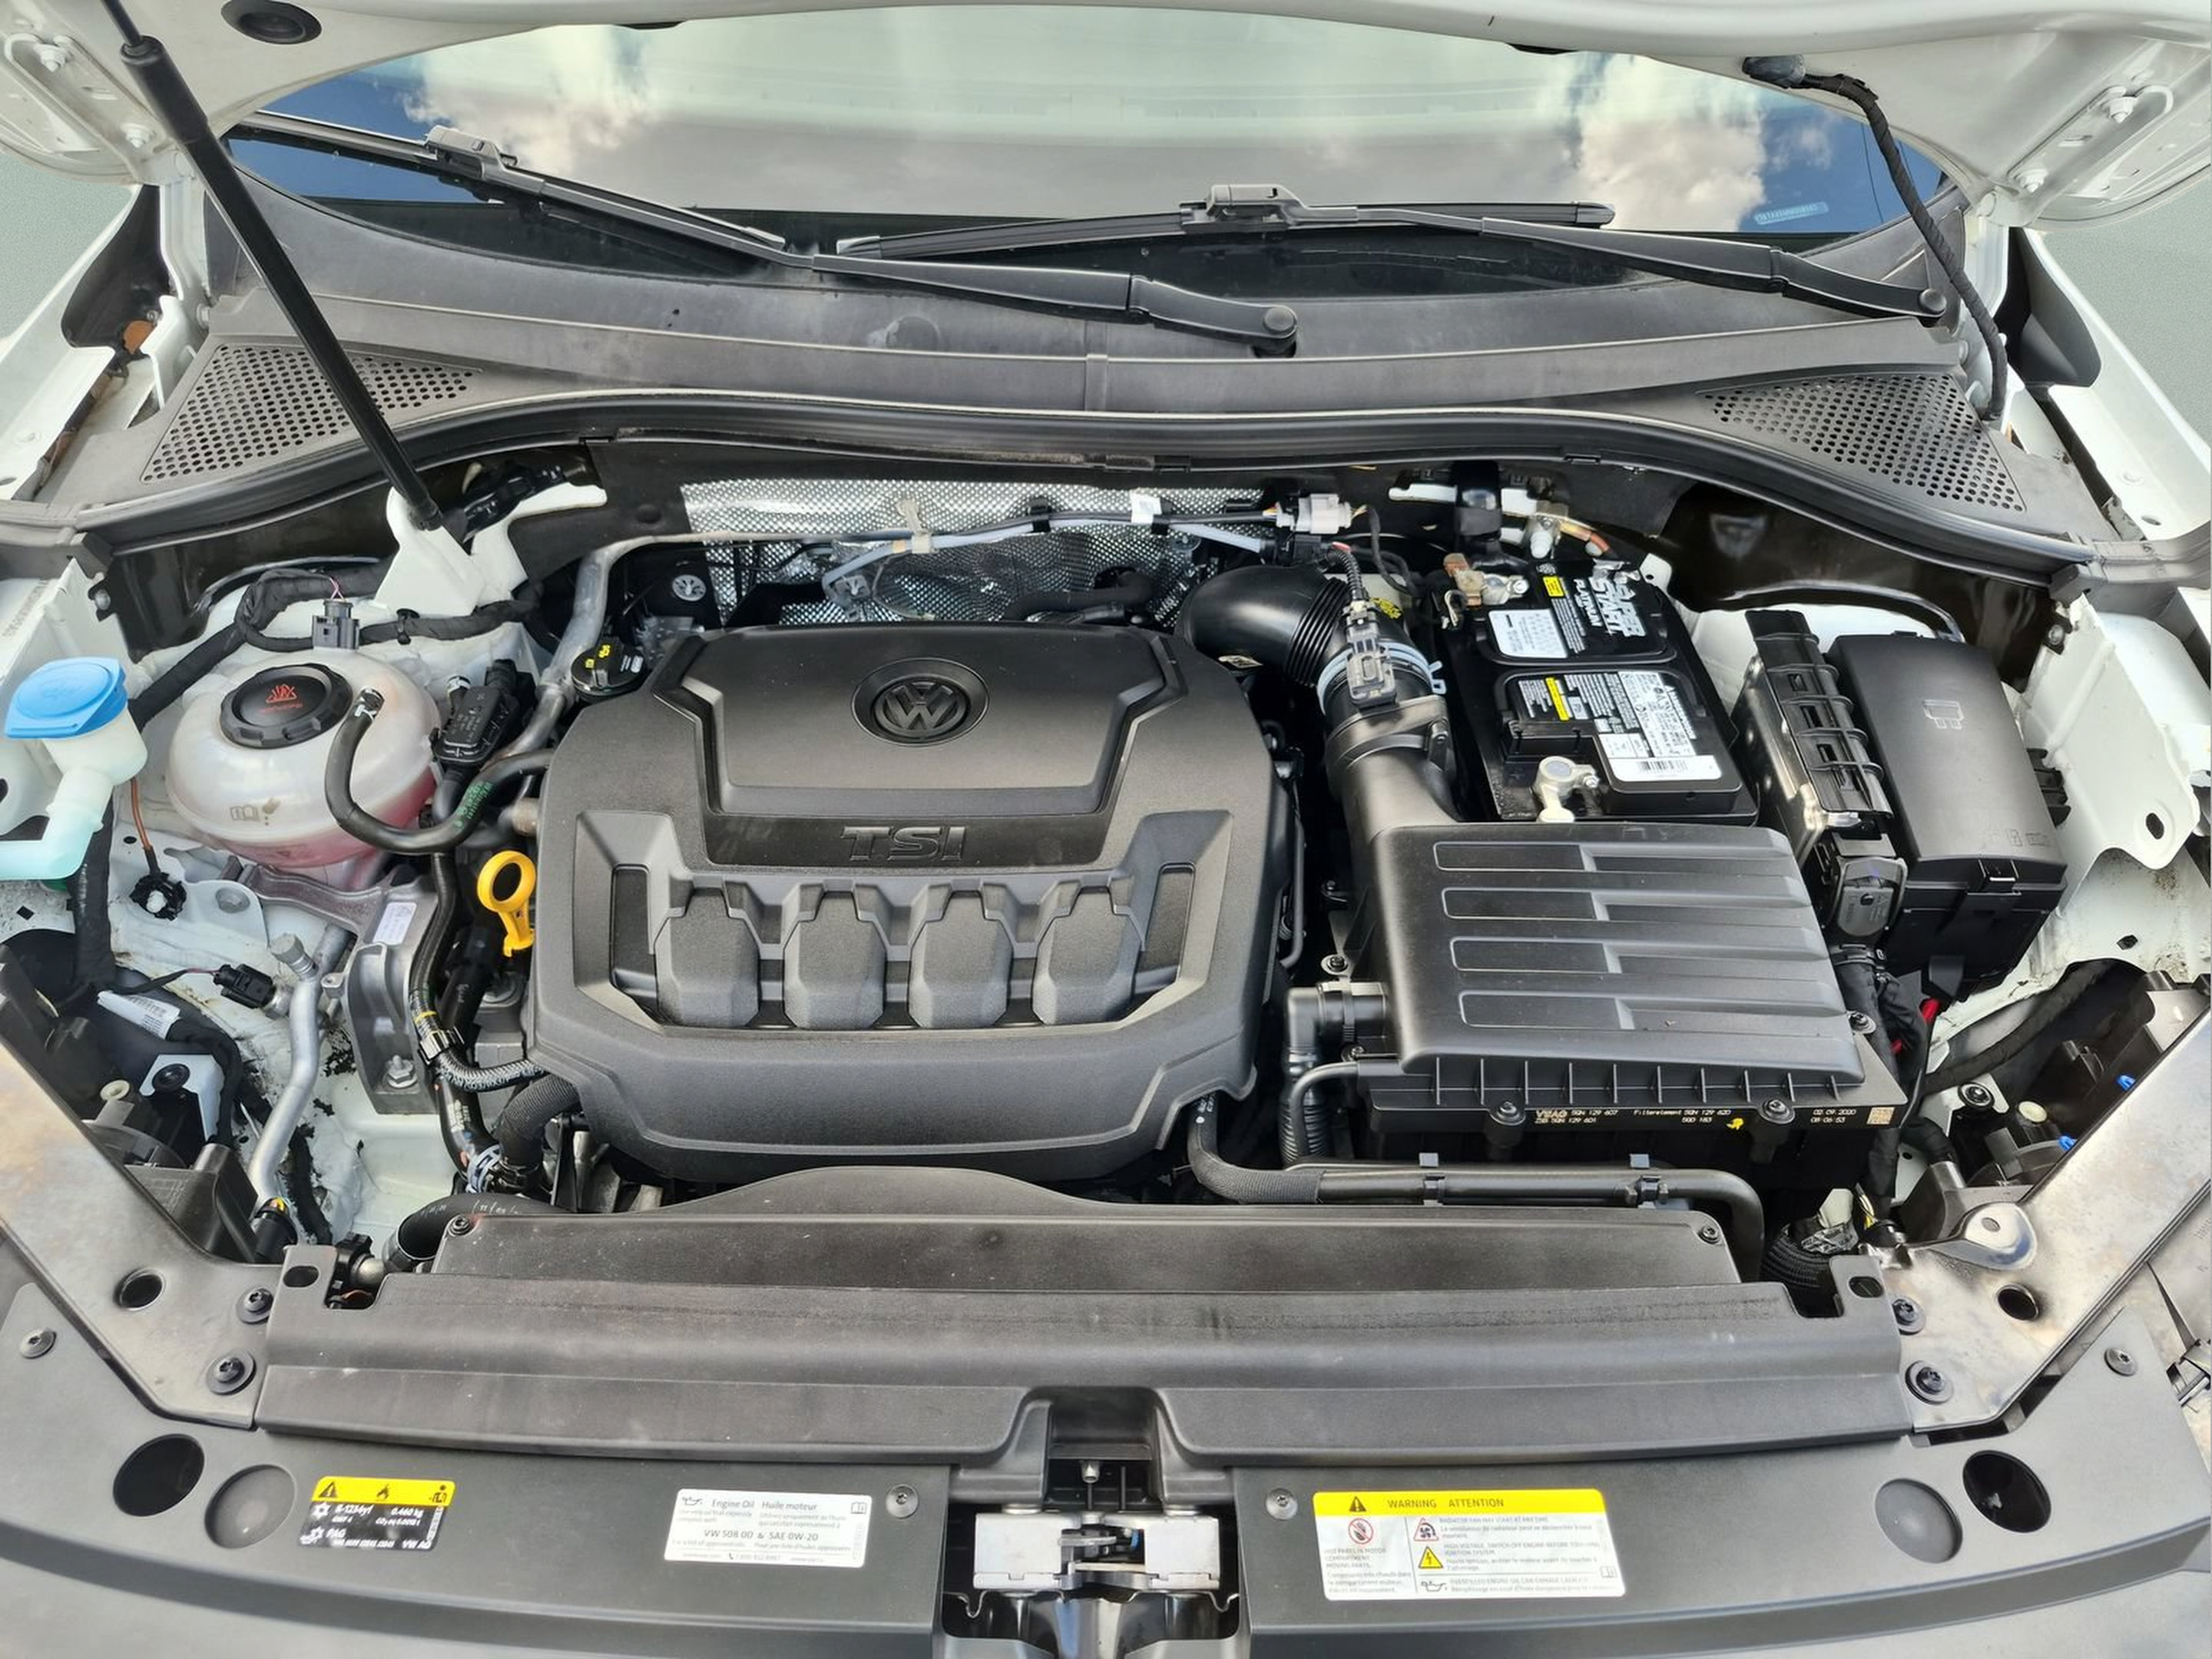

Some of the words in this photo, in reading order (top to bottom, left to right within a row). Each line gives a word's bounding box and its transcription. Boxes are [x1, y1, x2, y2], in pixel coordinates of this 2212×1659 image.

[1573, 578, 1604, 627] PLATINUM
[840, 826, 968, 862] TSI
[711, 1498, 740, 1509] Engine
[742, 1499, 755, 1508] Oil
[762, 1501, 783, 1510] Huile
[786, 1502, 818, 1511] moteur
[1387, 1498, 1437, 1508] WARNING
[1449, 1498, 1505, 1508] ATTENTION
[704, 1529, 721, 1538] VW
[722, 1529, 738, 1538] 508
[740, 1530, 754, 1538] 00
[769, 1532, 786, 1541] SAE
